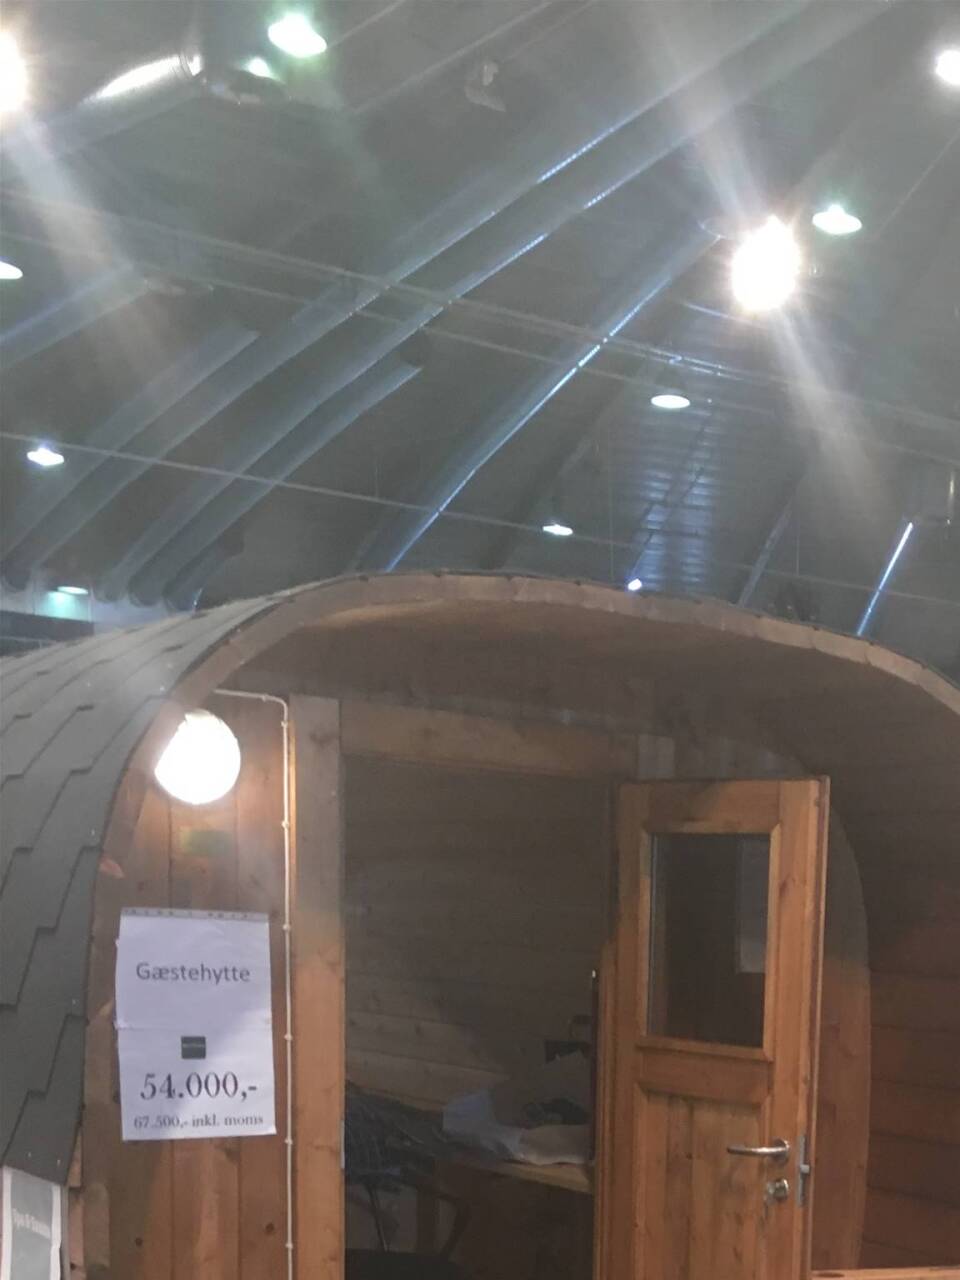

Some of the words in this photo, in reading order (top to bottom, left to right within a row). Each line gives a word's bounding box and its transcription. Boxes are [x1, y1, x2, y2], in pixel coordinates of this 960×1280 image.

[136, 962, 250, 985] Gæstehytte
[140, 1071, 257, 1101] 54.000,-
[192, 1113, 220, 1127] inkl.
[224, 1116, 263, 1126] moms
